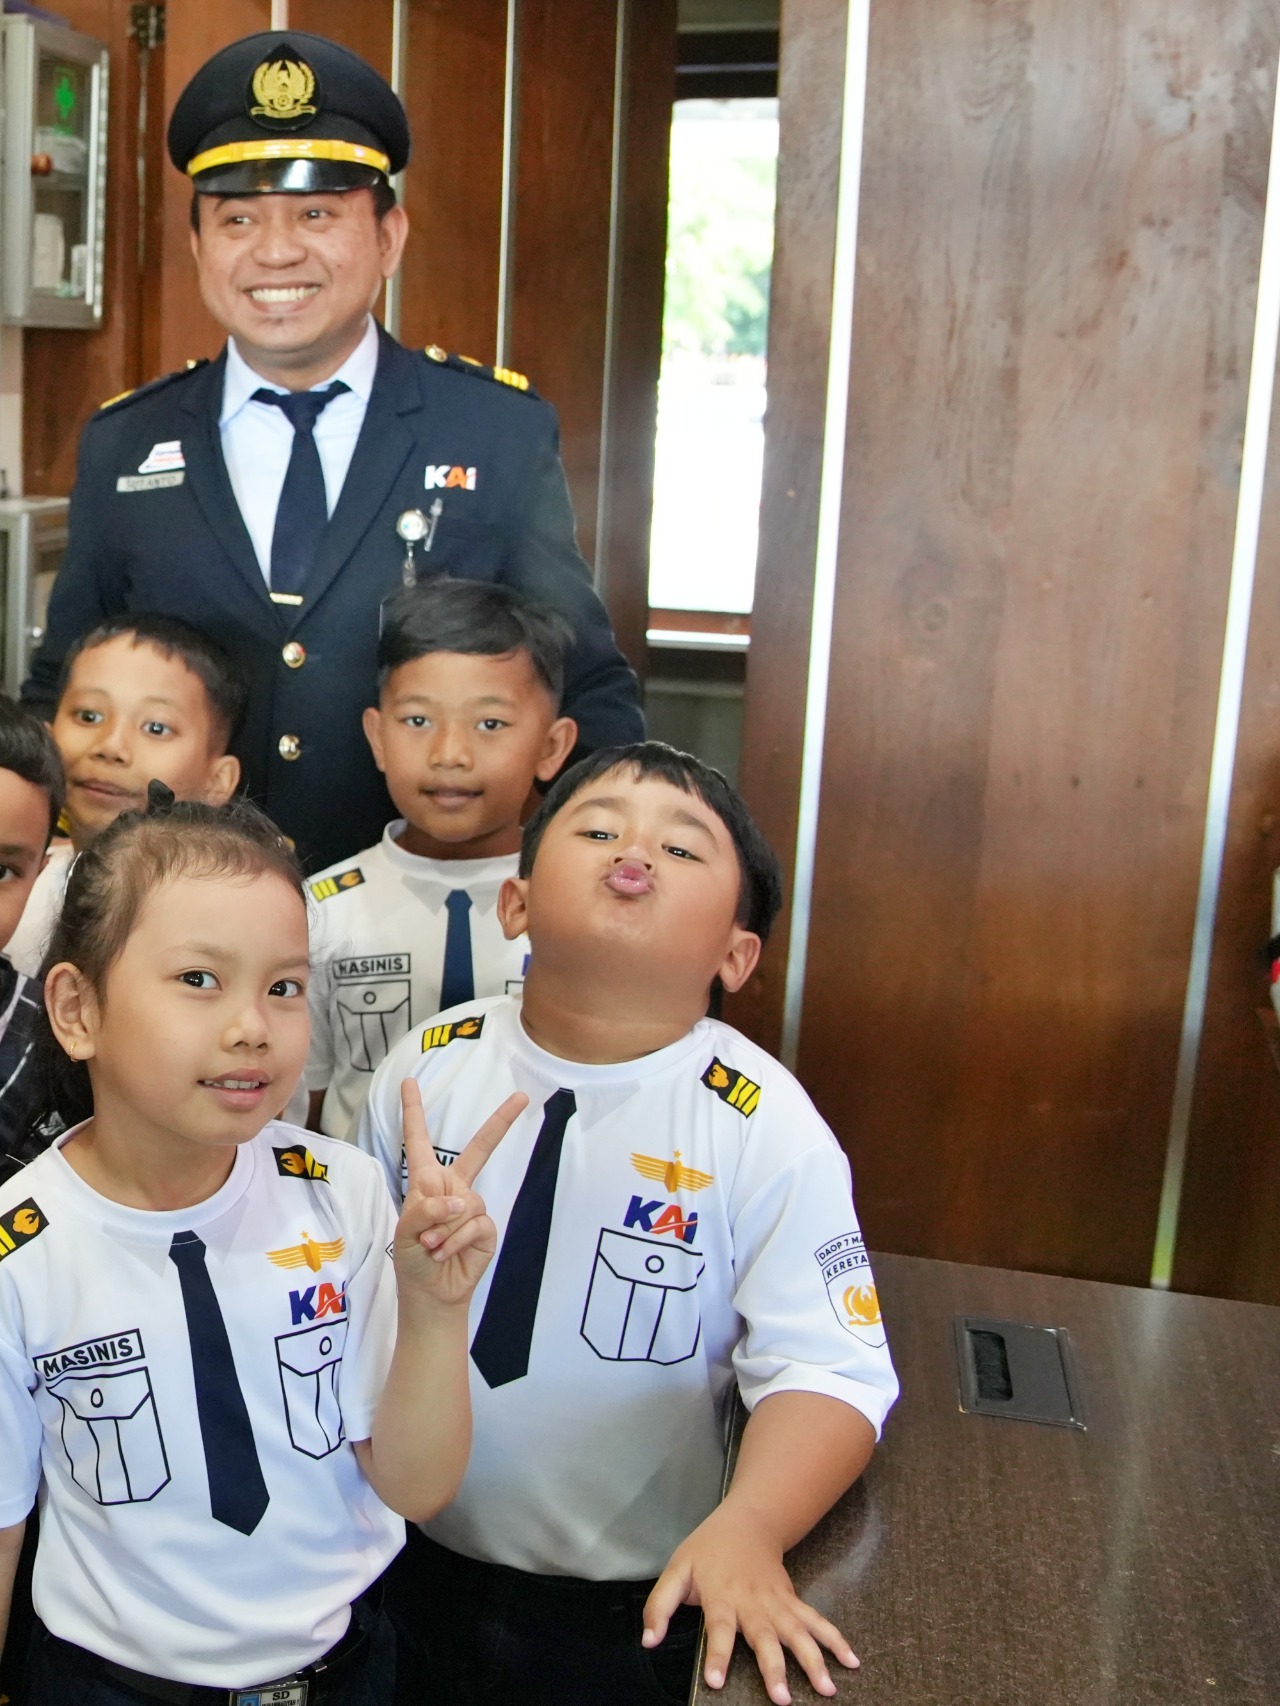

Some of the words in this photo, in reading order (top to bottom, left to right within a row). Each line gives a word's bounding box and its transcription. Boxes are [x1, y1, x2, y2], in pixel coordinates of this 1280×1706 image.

[424, 465, 477, 491] KAI
[623, 1195, 698, 1245] KAI
[818, 1241, 842, 1260] DAOP
[843, 1238, 849, 1247] 7
[826, 1254, 868, 1278] KERETA
[43, 1337, 133, 1377] MASINIS
[272, 1690, 290, 1701] SD
